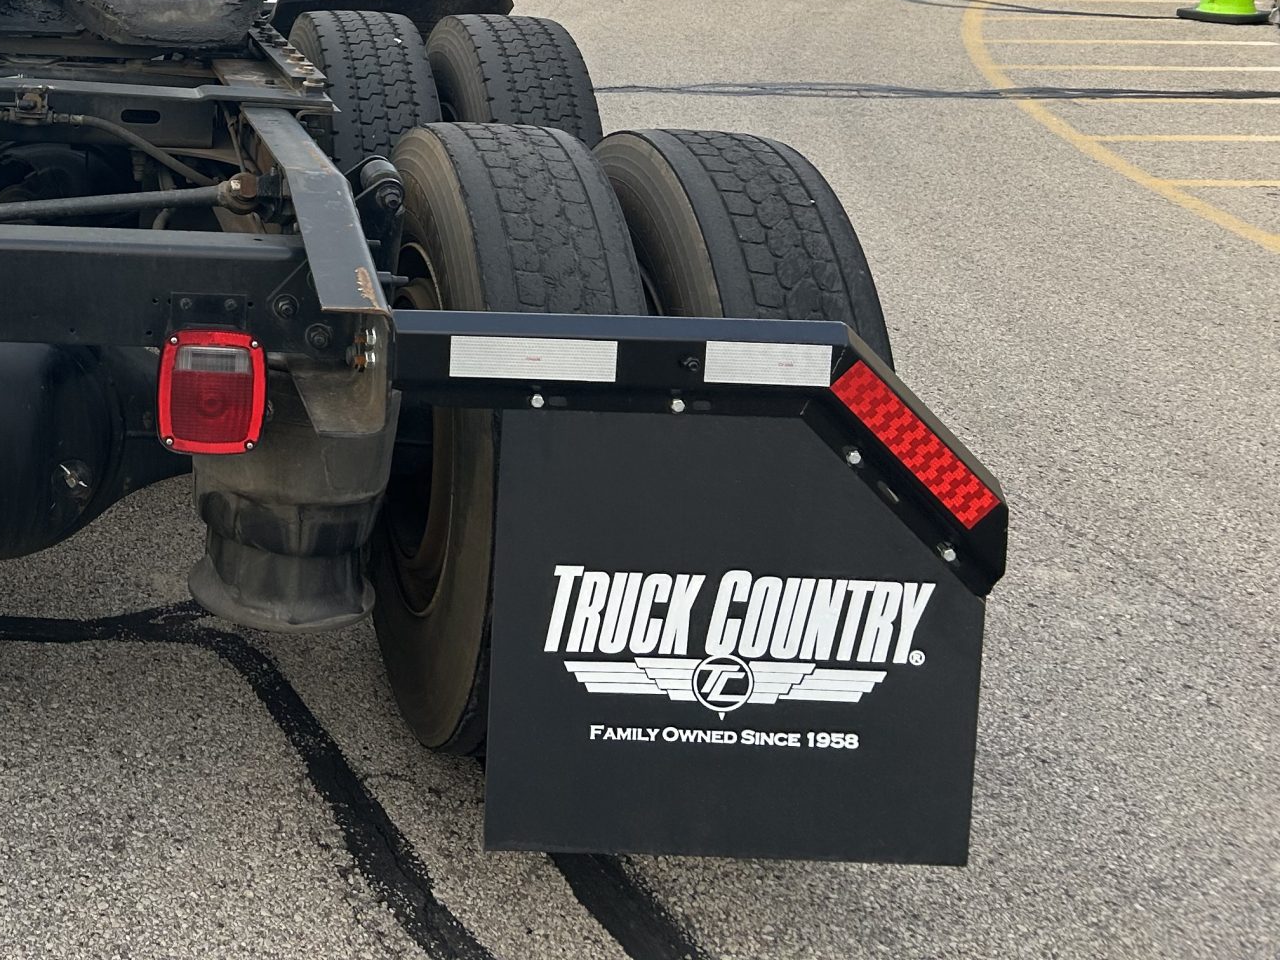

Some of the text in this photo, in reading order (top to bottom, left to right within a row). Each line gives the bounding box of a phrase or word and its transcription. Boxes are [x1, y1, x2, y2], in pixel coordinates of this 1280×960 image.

[543, 564, 707, 656] TRUCK
[589, 724, 860, 750] FAMILY OWNED SINCE 1958
